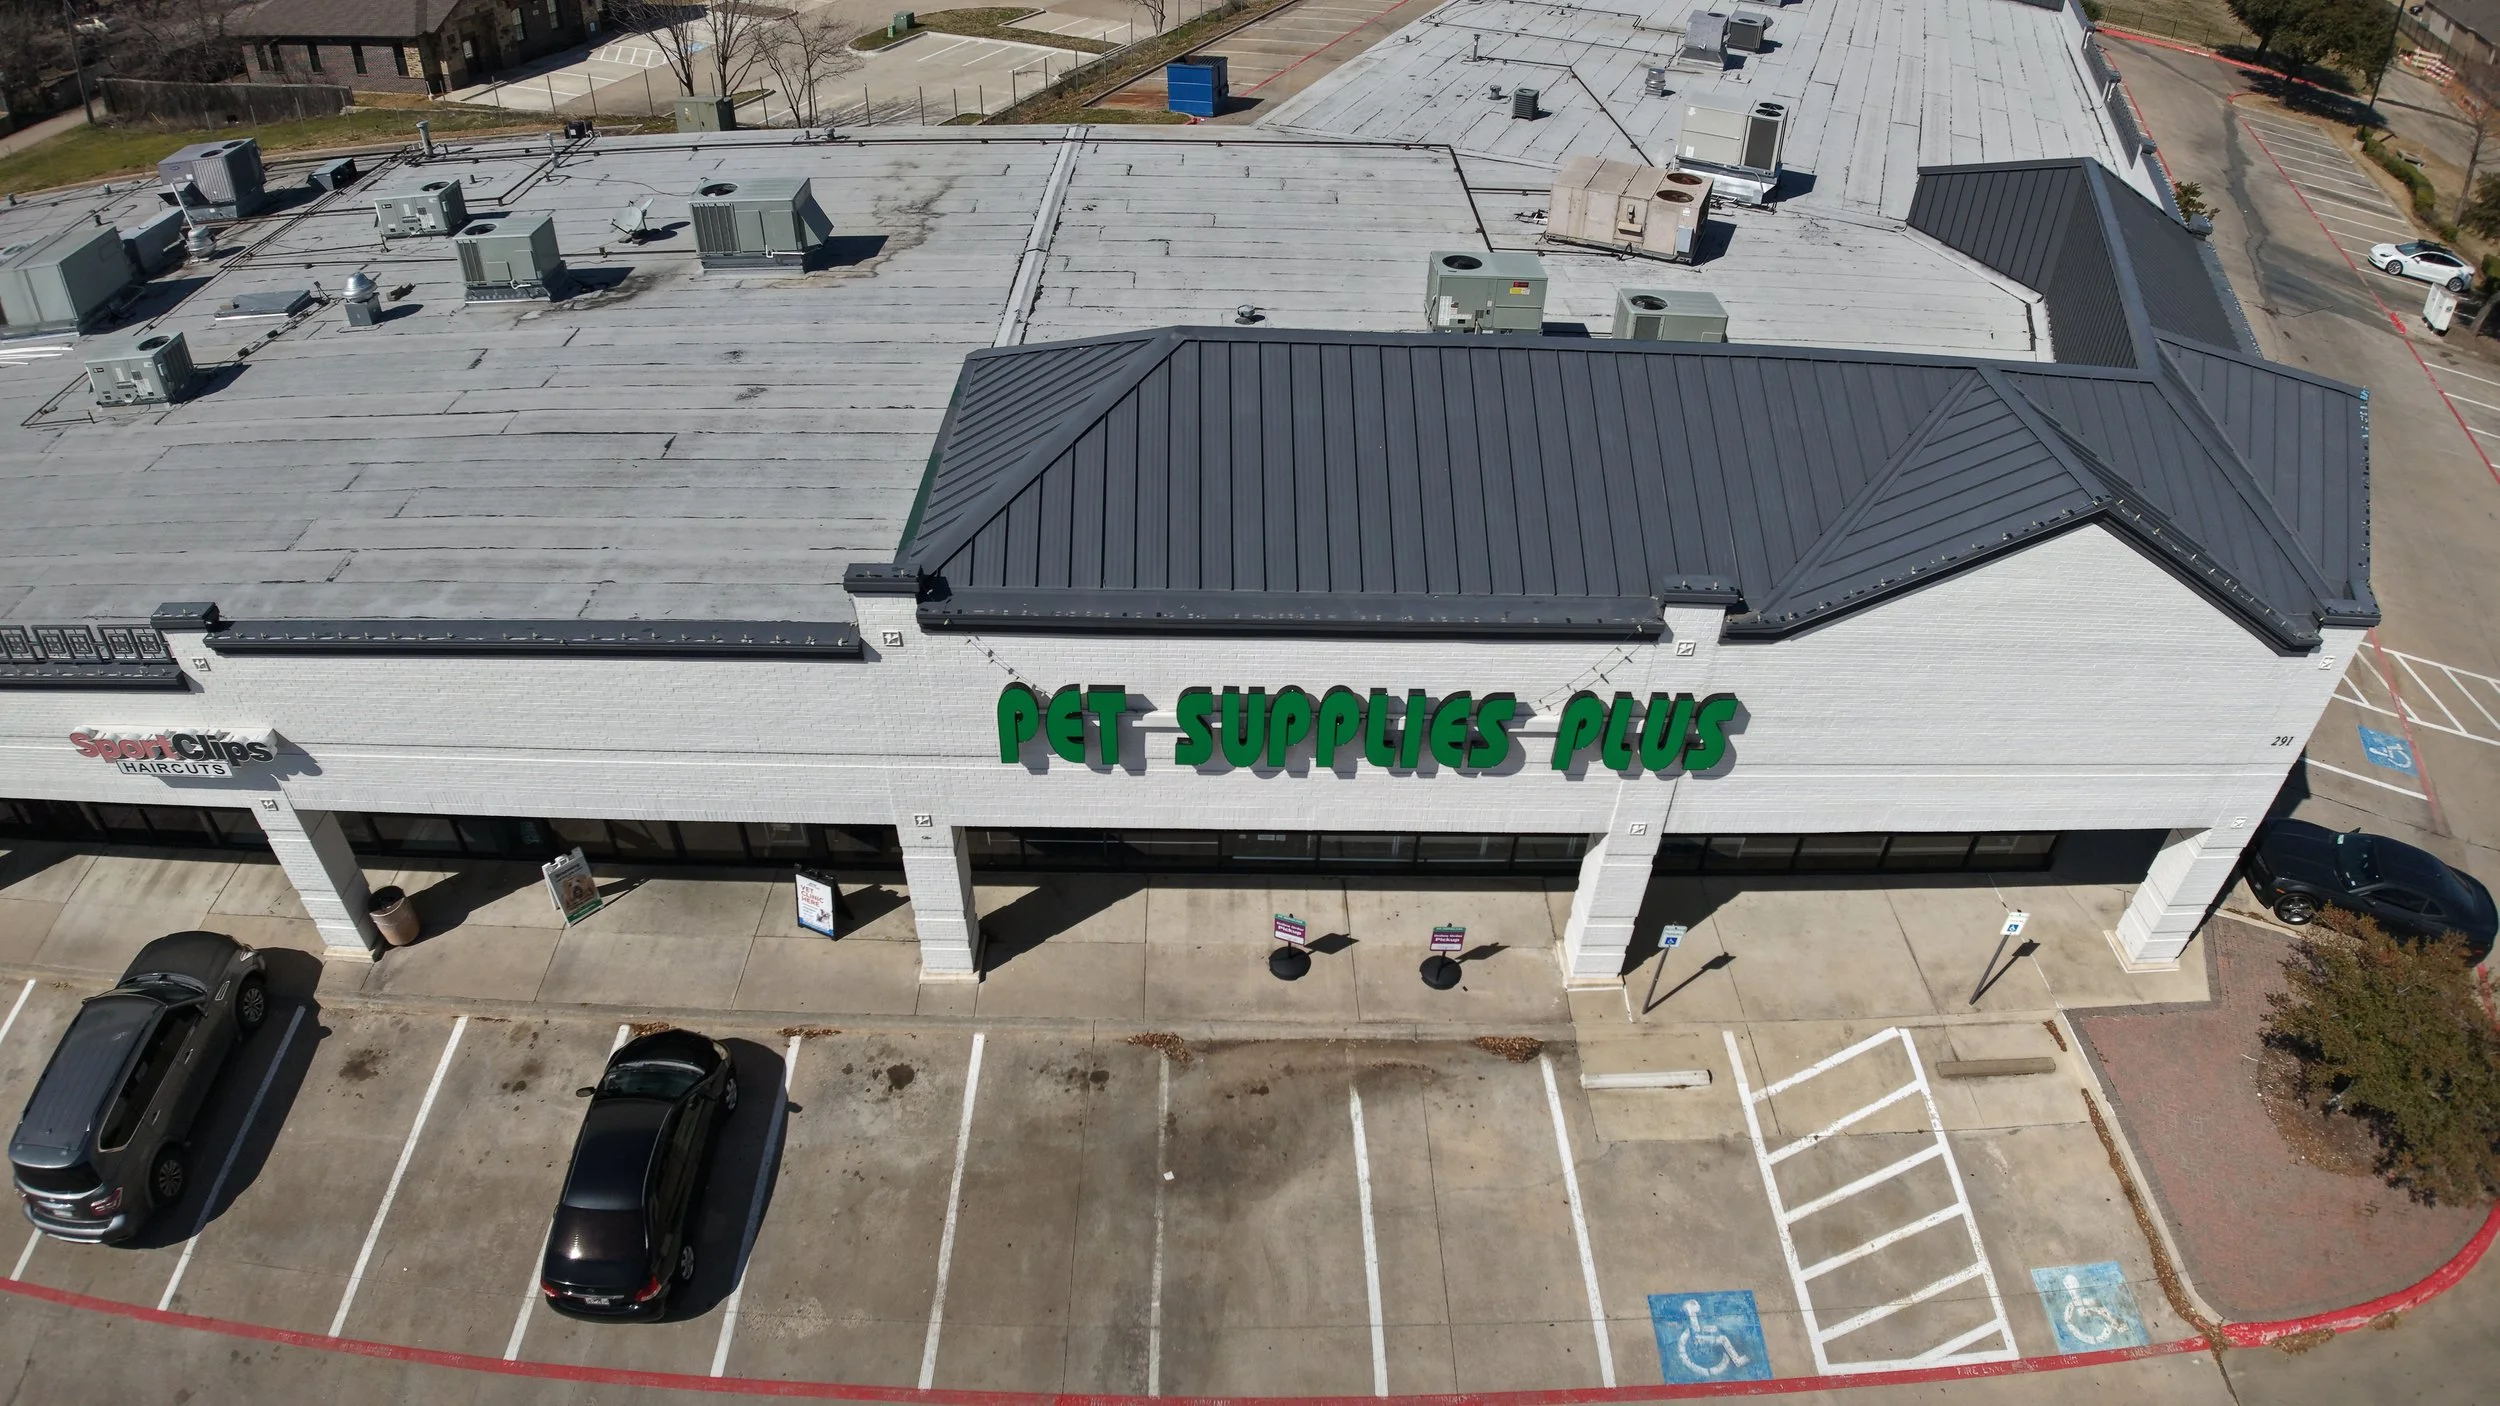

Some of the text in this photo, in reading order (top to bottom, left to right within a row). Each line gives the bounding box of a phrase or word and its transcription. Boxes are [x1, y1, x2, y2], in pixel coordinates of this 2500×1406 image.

[997, 683, 1739, 772] PET SUPPLIES PLUS
[2270, 735, 2295, 747] 291
[123, 761, 227, 776] HAIRCUTS
[800, 884, 814, 894] VET
[800, 890, 825, 904] CLINIC
